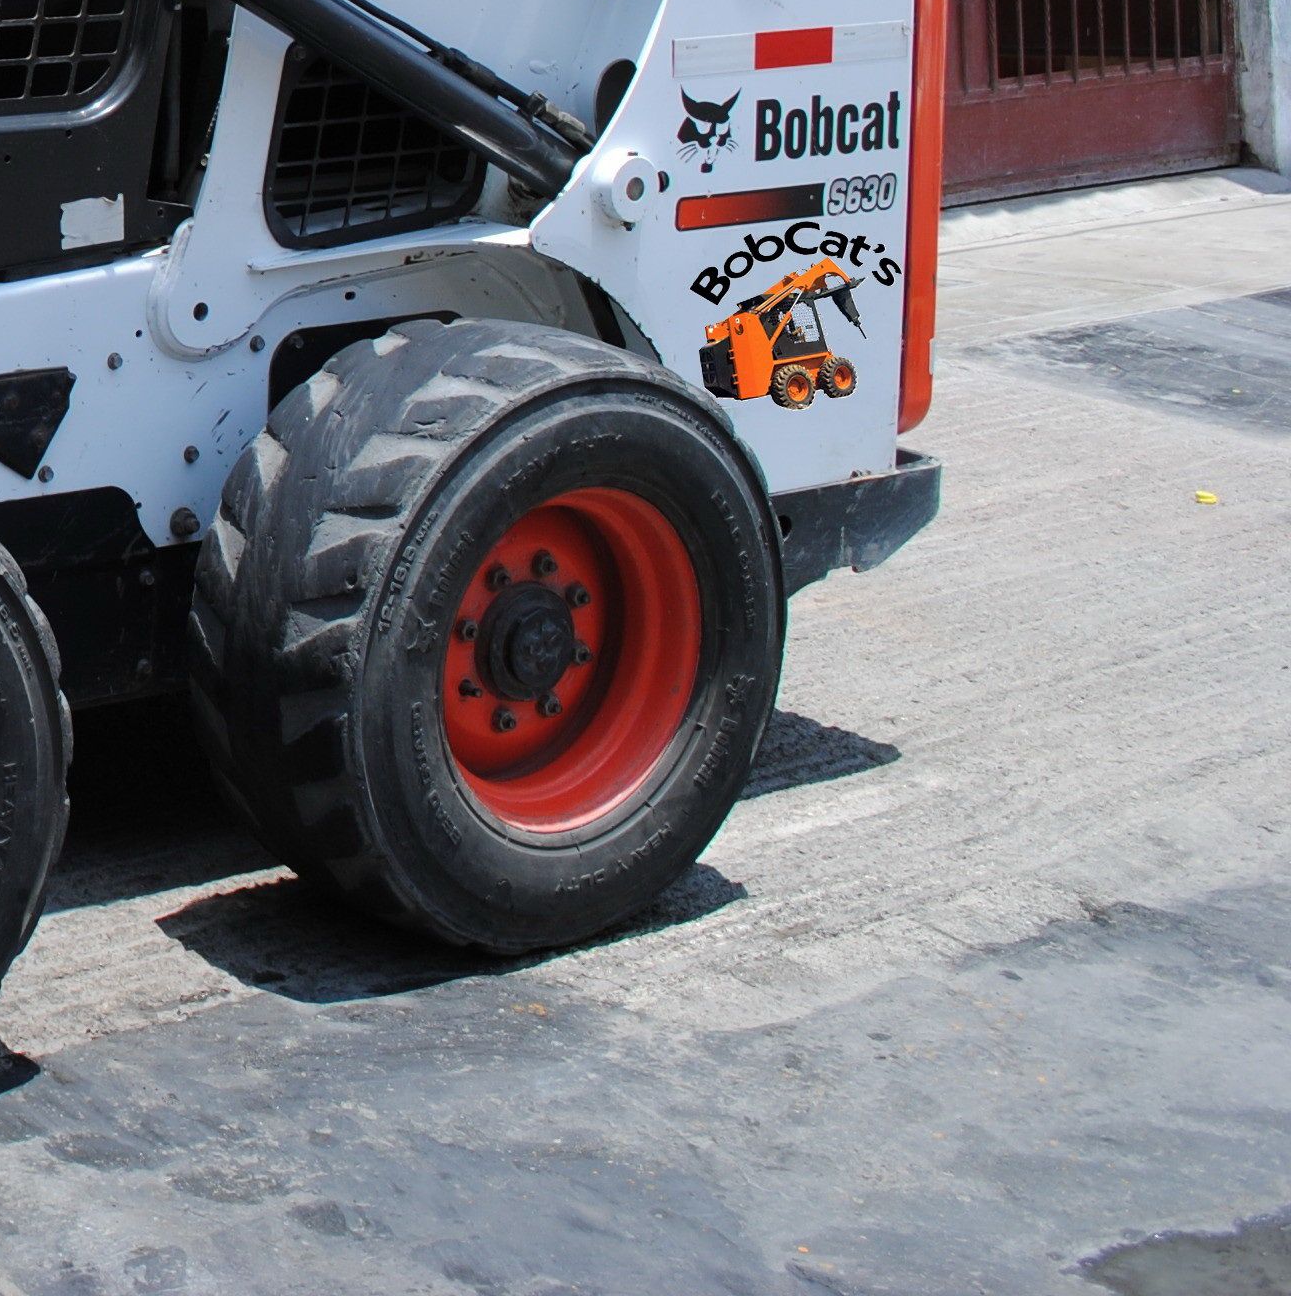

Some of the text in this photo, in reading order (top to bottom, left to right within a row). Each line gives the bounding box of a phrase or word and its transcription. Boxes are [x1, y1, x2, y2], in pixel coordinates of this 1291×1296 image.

[754, 90, 901, 162] Bobcat
[826, 171, 898, 217] S630
[689, 220, 903, 306] BobCat's
